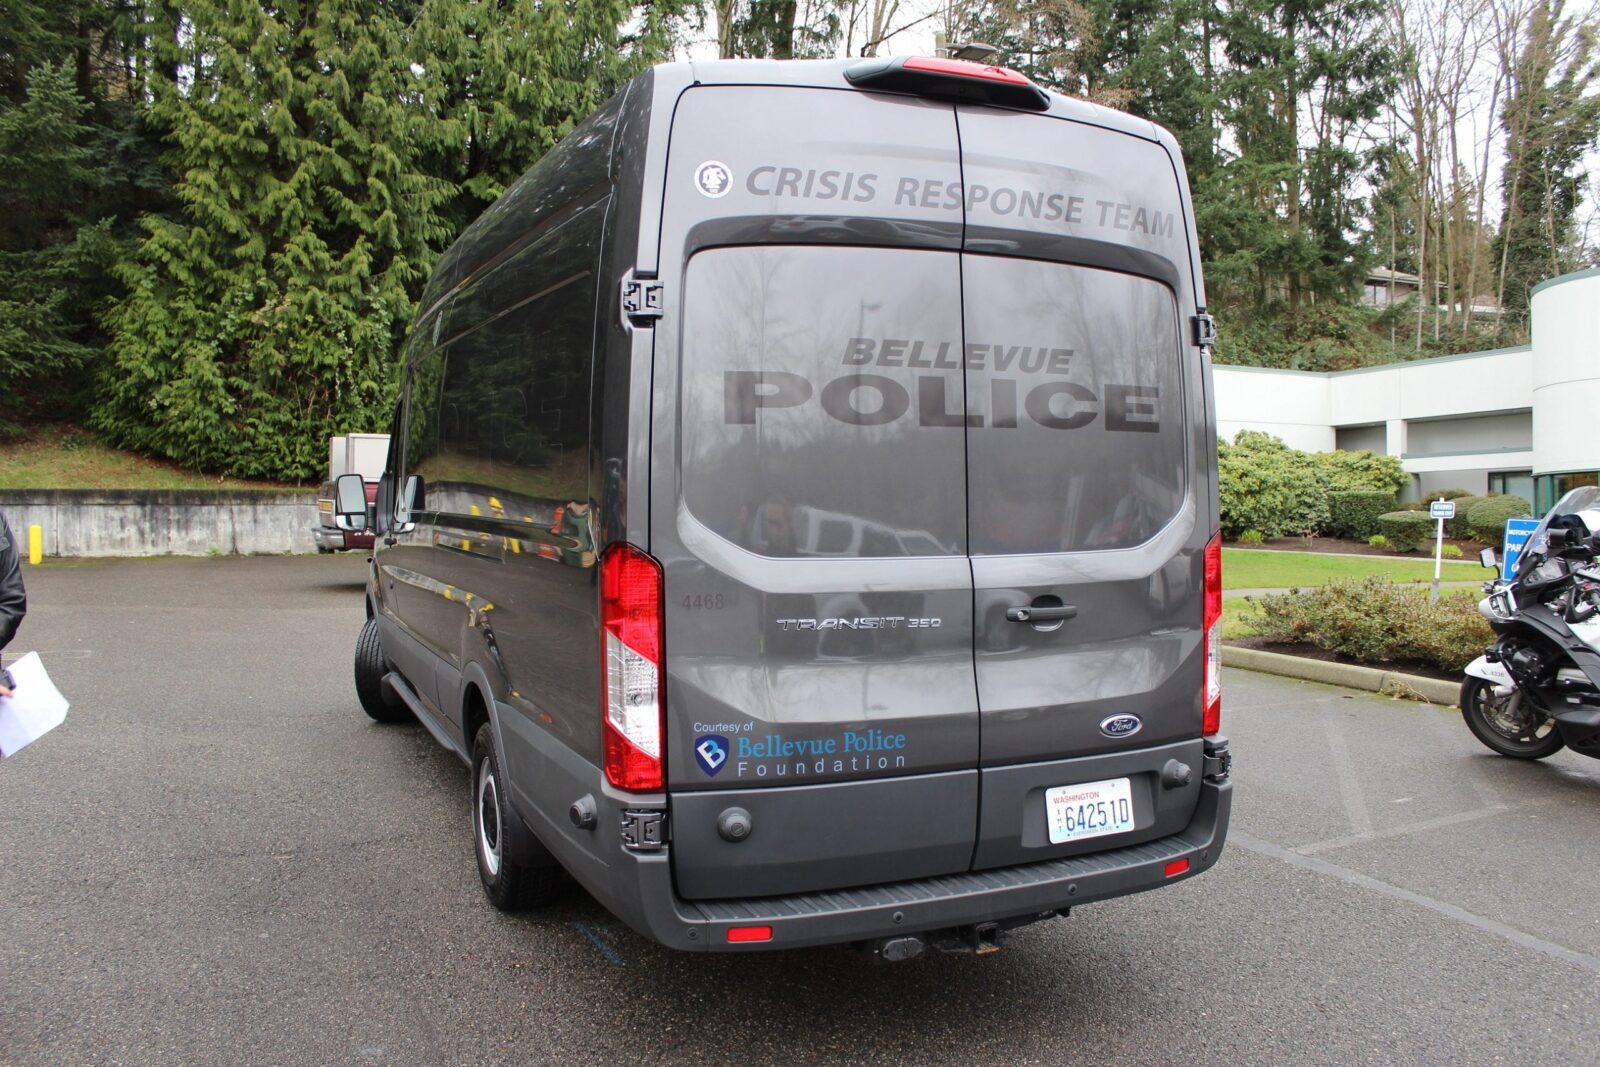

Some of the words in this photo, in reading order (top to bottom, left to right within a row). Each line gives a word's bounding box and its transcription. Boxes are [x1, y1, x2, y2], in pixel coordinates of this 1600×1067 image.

[746, 165, 878, 202] CRISIS
[894, 176, 1084, 224] RESPONSE
[1095, 200, 1174, 238] TEAM
[842, 337, 1074, 375] BELLEVUE
[723, 370, 1160, 433] POLICE
[1506, 543, 1522, 552] PAR
[681, 593, 725, 610] 4468
[776, 616, 905, 631] TRANSIT
[907, 618, 941, 628] 350
[693, 722, 740, 735] Courtesy
[743, 721, 754, 732] of
[1111, 719, 1133, 732] Ford
[737, 735, 836, 758] Bellevue
[843, 729, 906, 752] Police
[738, 754, 905, 777] Foundation
[1053, 791, 1100, 804] WASHINGTON
[1065, 798, 1130, 832] 64251D
